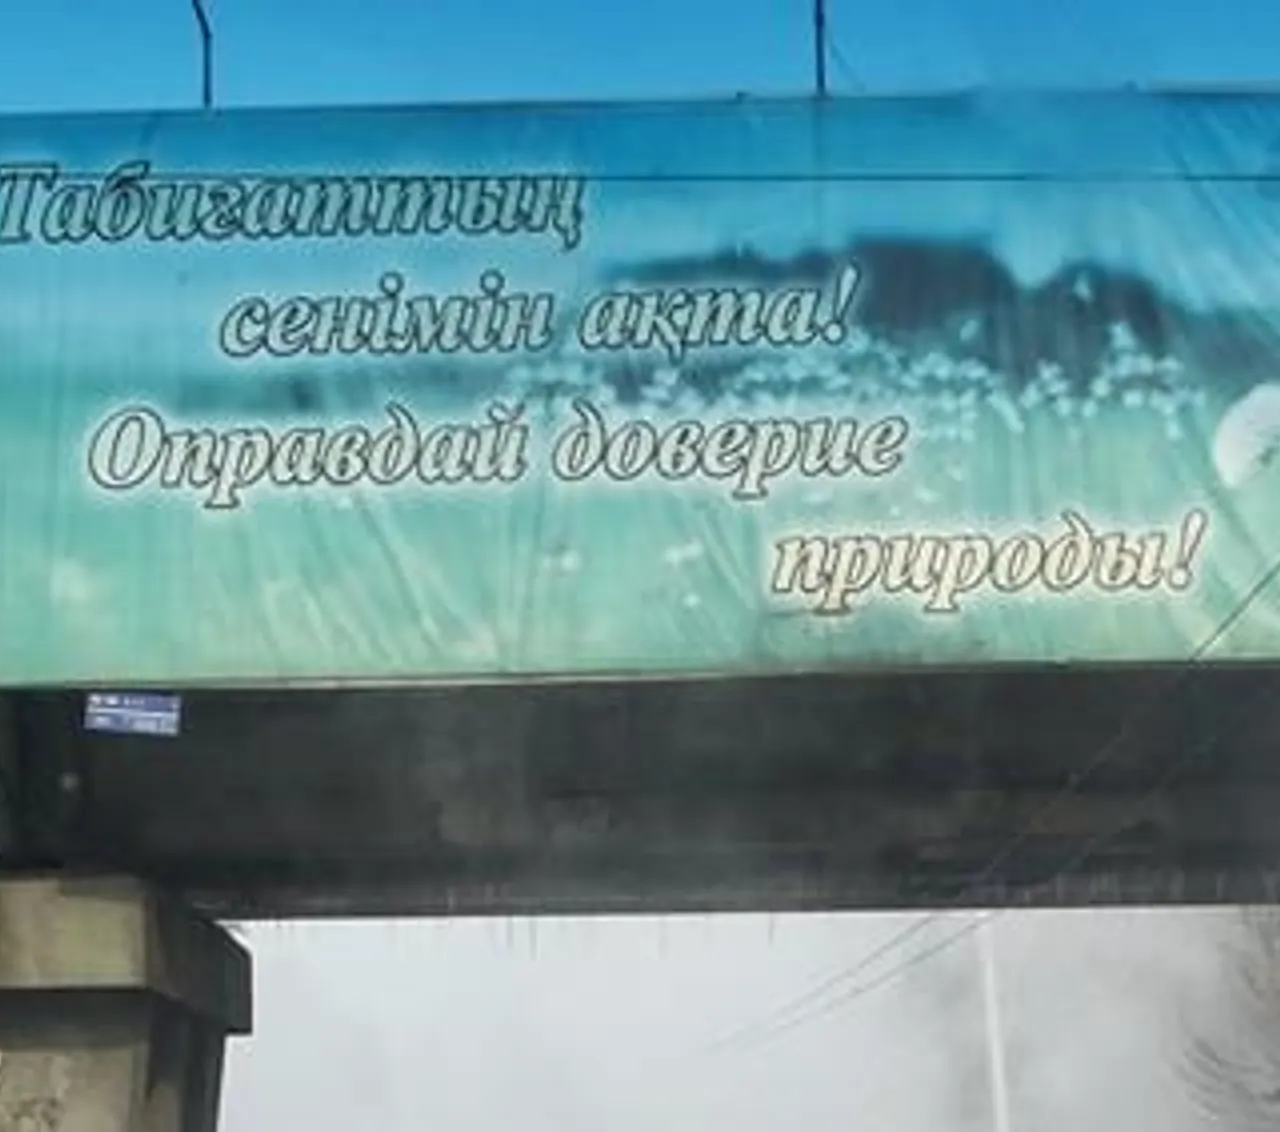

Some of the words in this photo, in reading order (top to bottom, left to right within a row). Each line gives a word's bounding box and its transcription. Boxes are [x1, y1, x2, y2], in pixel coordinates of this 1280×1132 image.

[220, 268, 556, 356] сенімін
[579, 262, 862, 365] ақта!
[88, 402, 530, 510] Оправдай
[553, 400, 912, 500] доверие
[772, 508, 1209, 615] природы!
